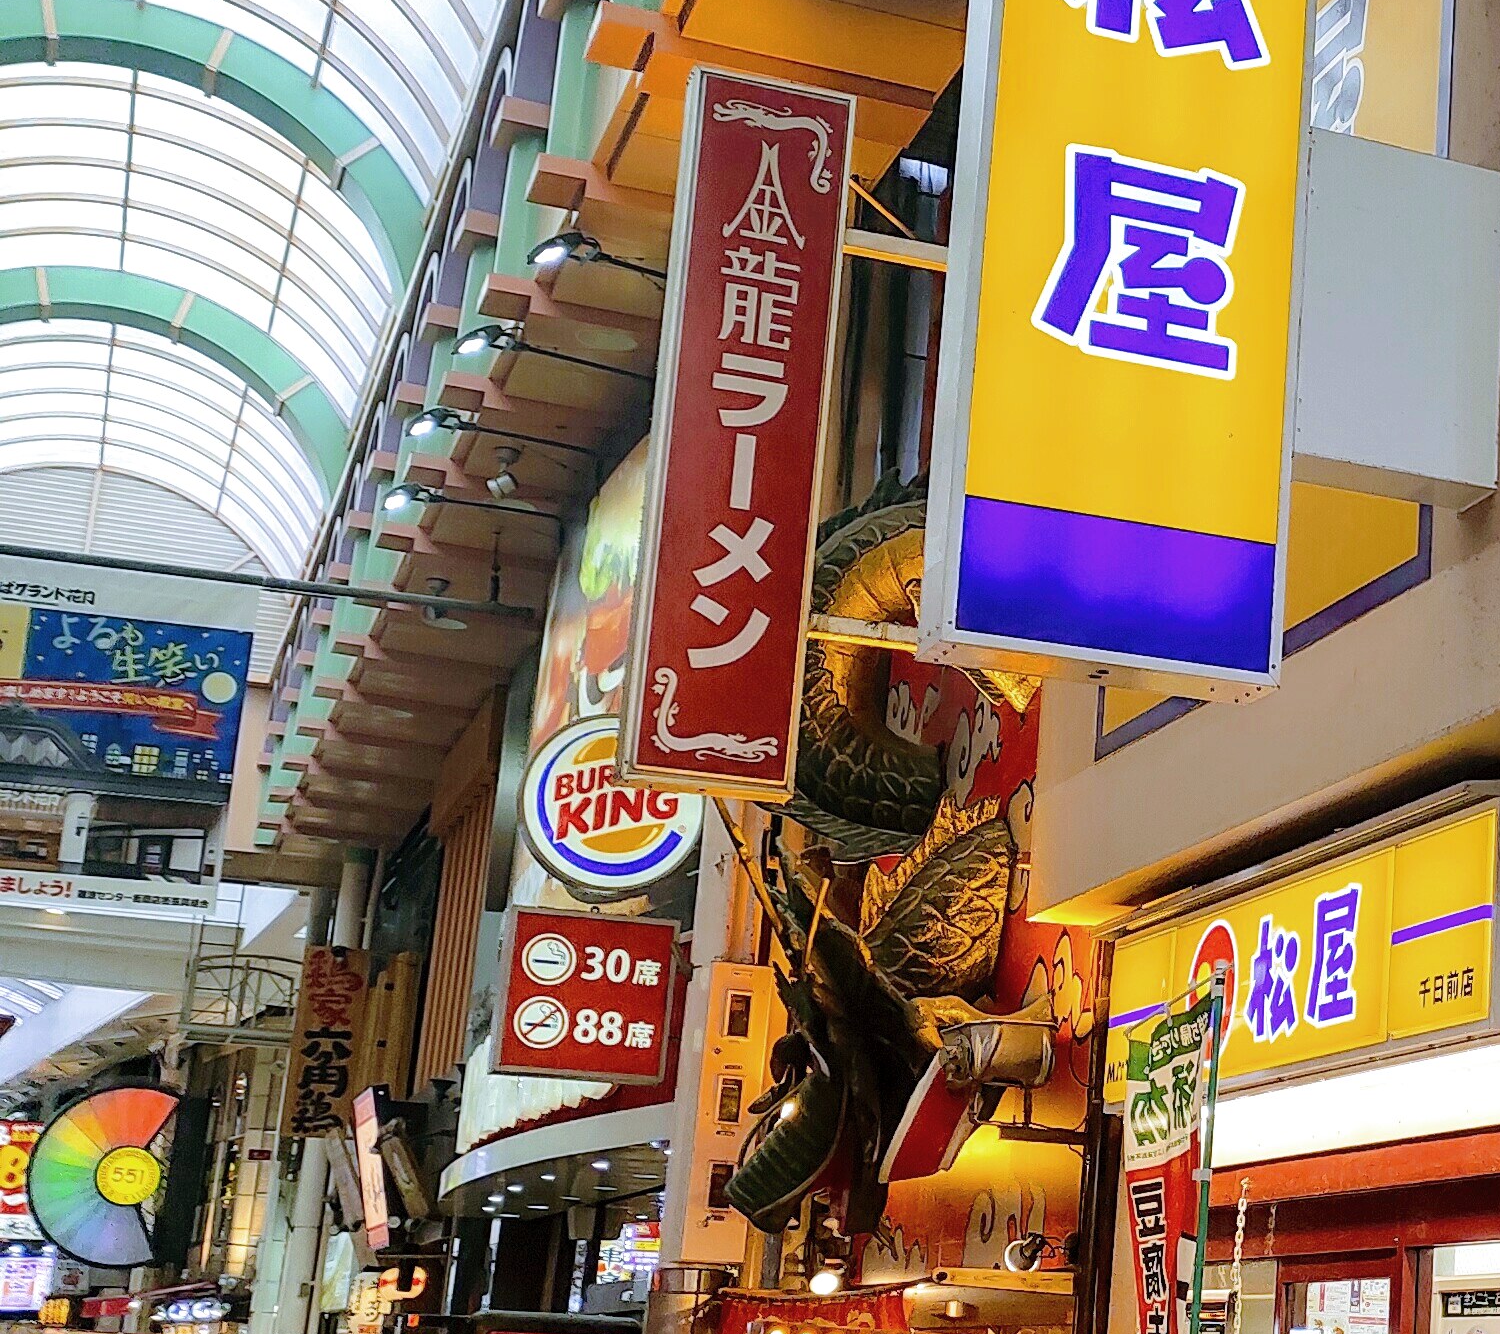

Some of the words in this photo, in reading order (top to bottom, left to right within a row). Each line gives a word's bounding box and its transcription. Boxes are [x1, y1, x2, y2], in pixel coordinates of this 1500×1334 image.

[689, 142, 805, 670] 金龍ラーメン
[555, 788, 679, 842] KING
[580, 946, 661, 986] 30席
[1245, 882, 1362, 1043] 松屋
[1418, 966, 1474, 1009] 千日前店
[572, 1008, 655, 1050] 88席
[112, 1167, 144, 1184] 551
